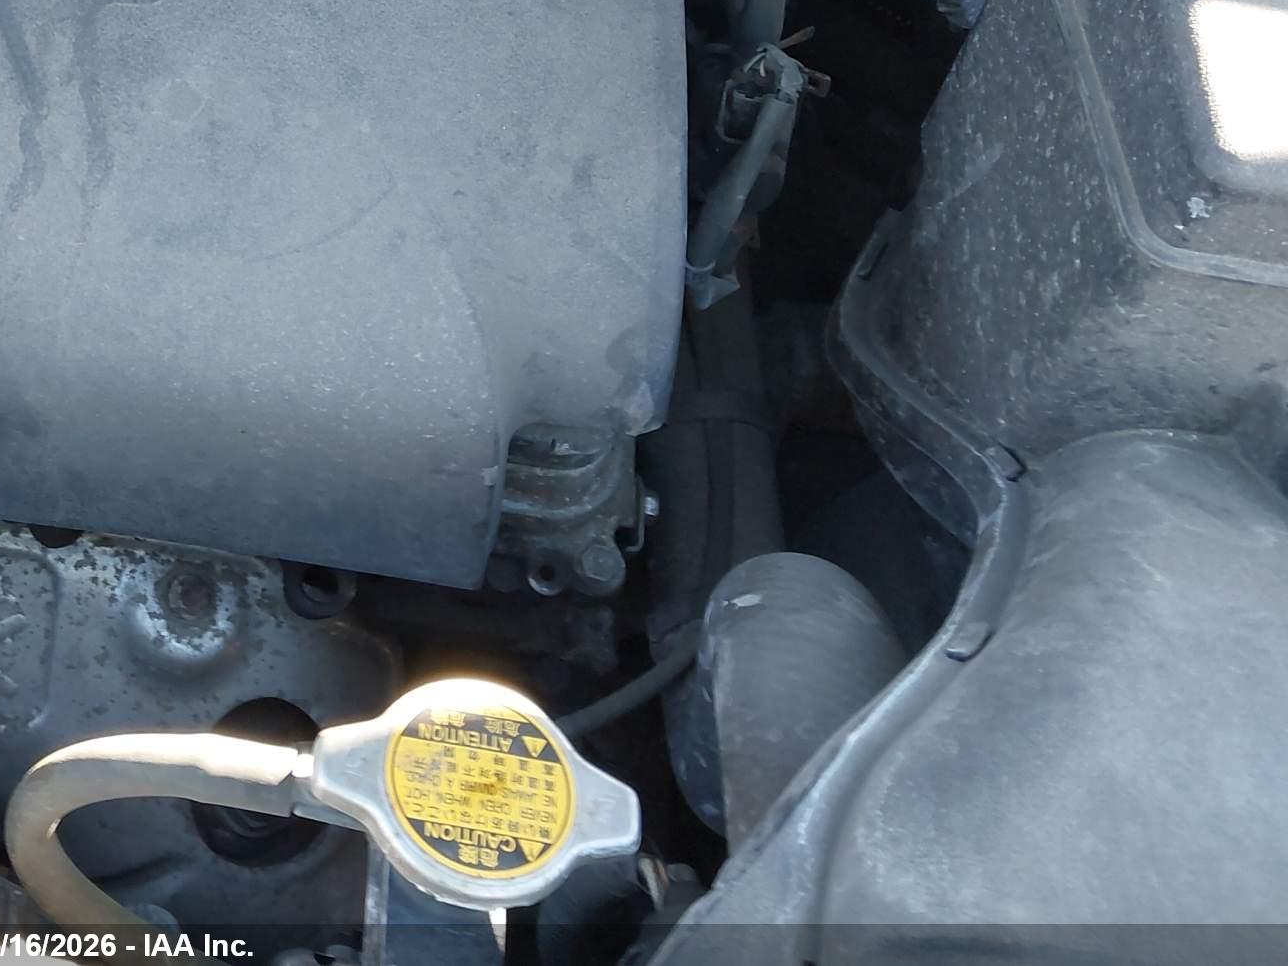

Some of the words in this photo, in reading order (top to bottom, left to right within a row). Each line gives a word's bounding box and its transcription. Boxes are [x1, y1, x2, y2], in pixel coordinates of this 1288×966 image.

[417, 722, 512, 751] ATTENTION
[435, 791, 471, 808] WHEN
[478, 798, 512, 815] OPEN
[519, 807, 556, 823] NEVER
[423, 822, 516, 851] CAUTION
